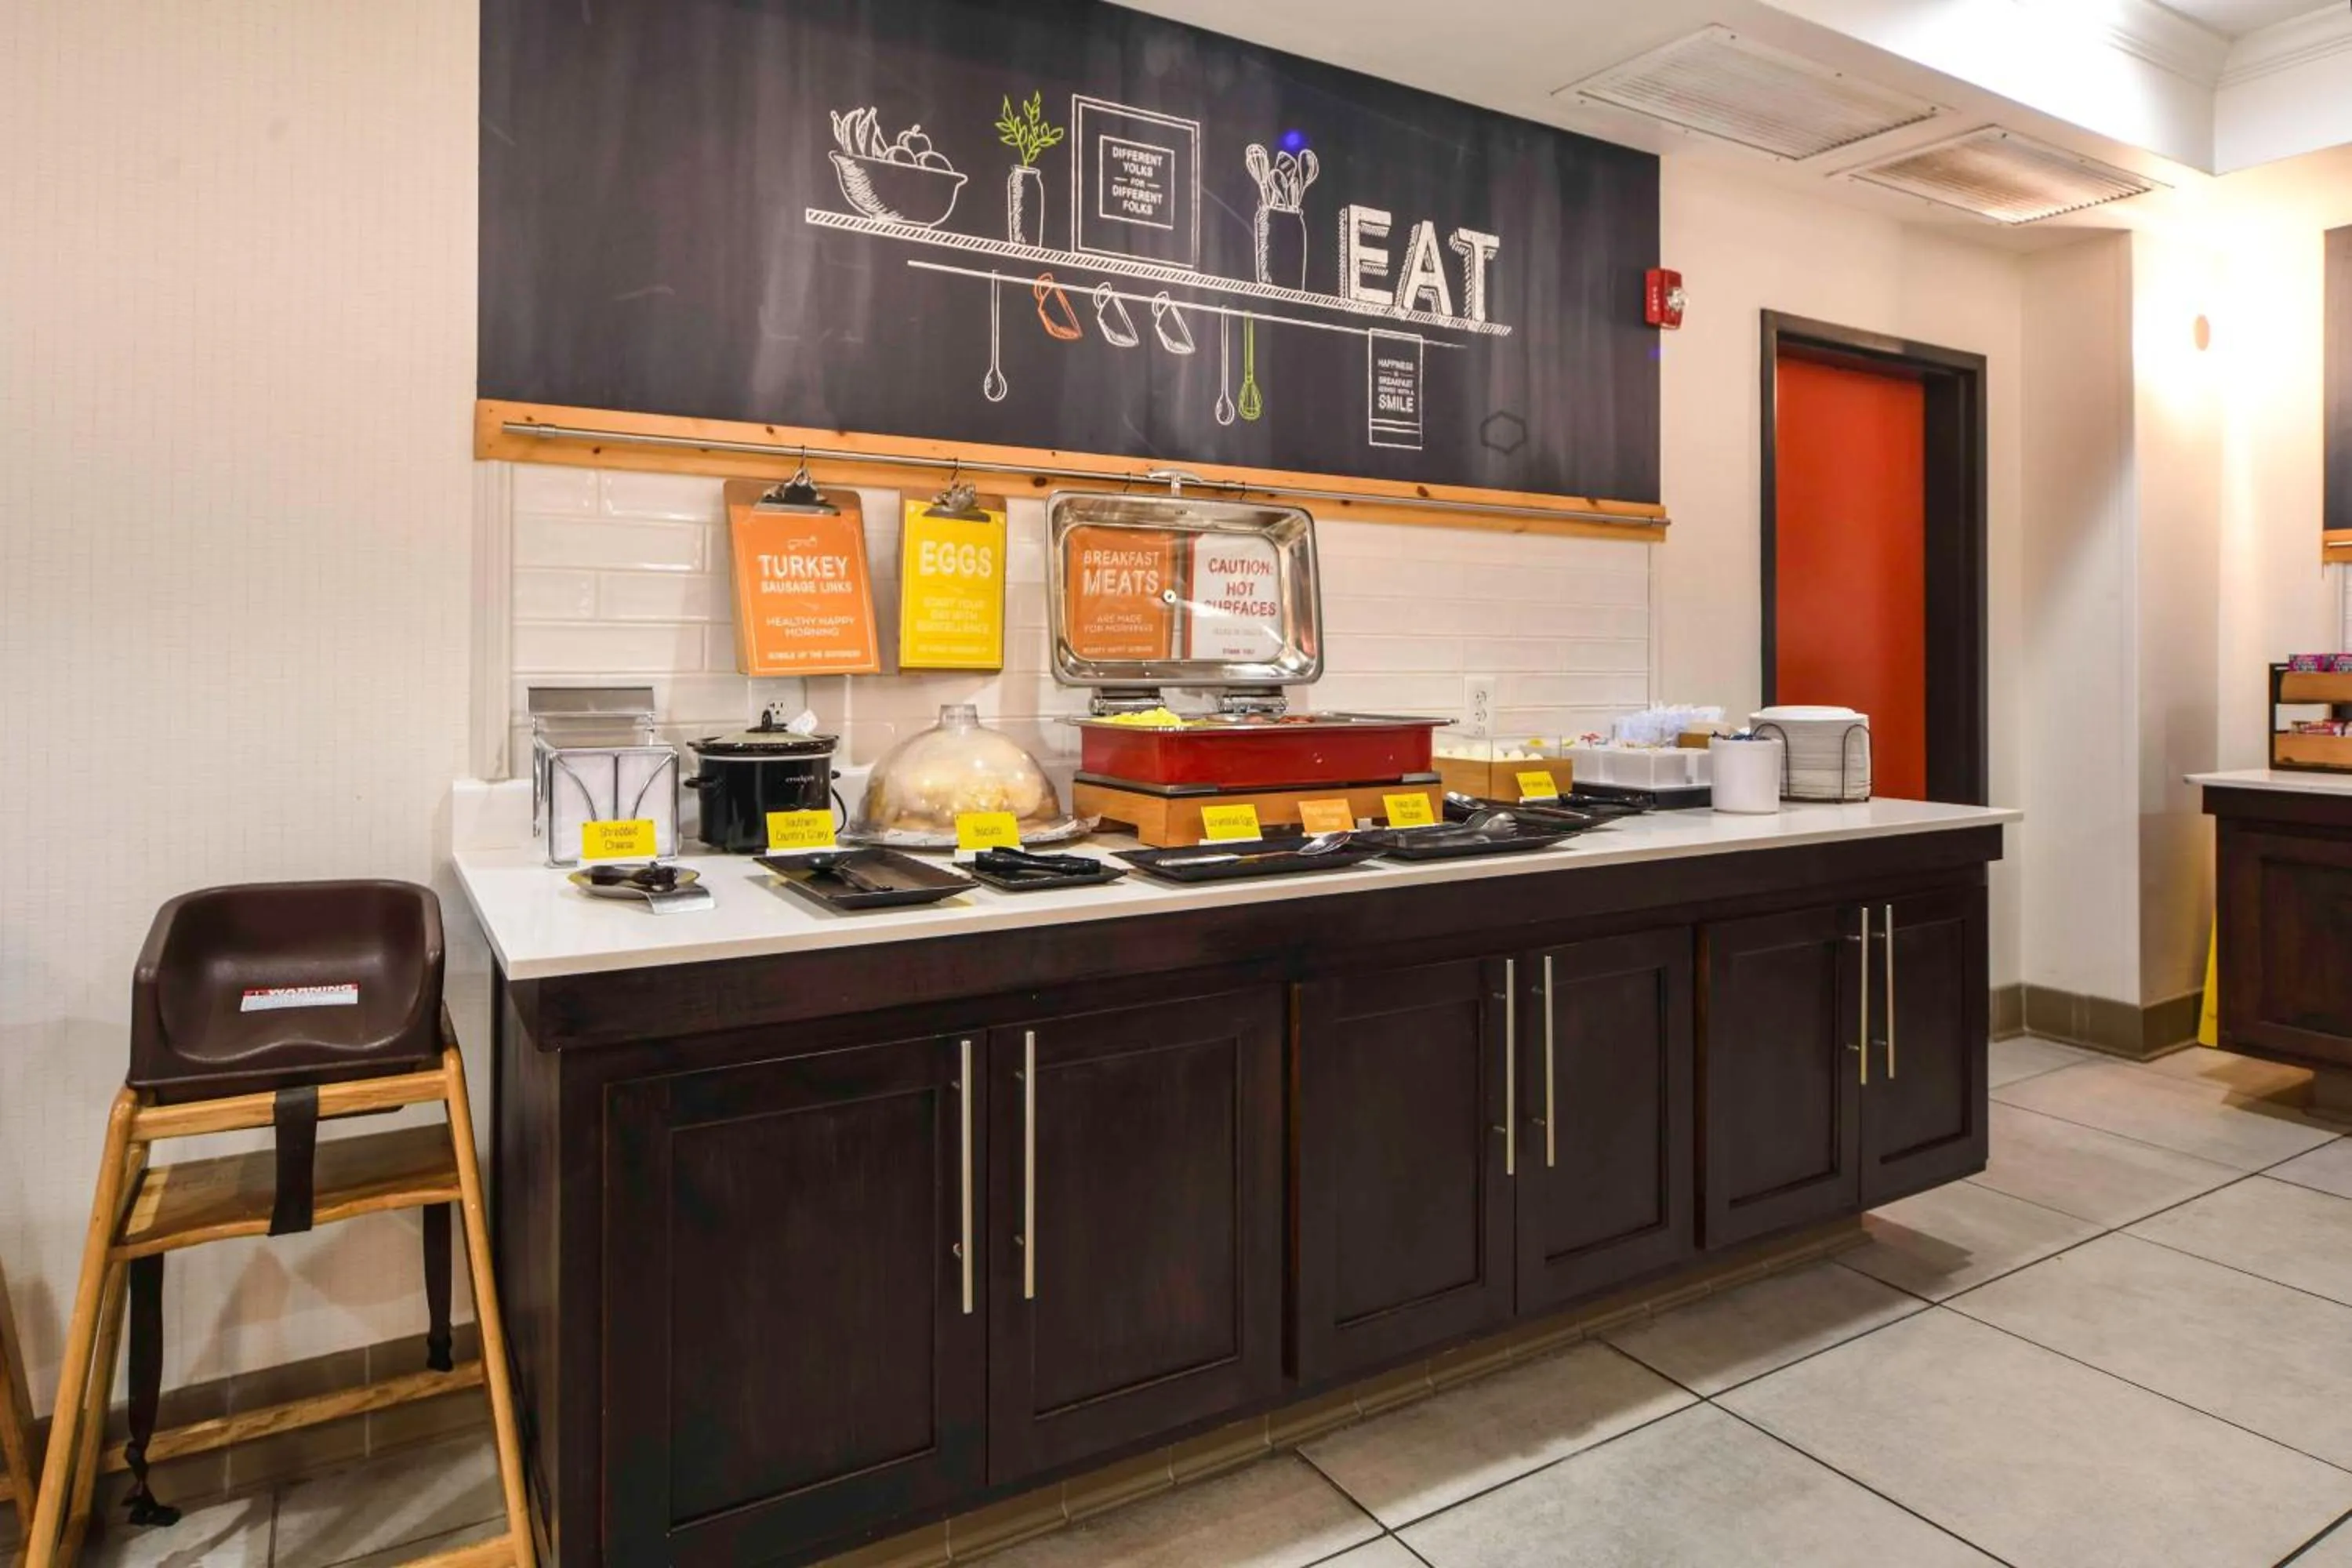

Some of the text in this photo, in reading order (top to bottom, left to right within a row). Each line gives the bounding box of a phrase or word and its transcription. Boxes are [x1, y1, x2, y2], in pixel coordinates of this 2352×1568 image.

[1112, 146, 1163, 166] DIFFERENT
[1123, 162, 1153, 177] YOLKS
[1131, 177, 1145, 188] FOR
[1112, 184, 1163, 204] DIFFERENT
[1123, 200, 1153, 215] FOLKS
[1338, 204, 1500, 322] EAT
[1377, 358, 1414, 371] HAPPINESS
[1378, 376, 1413, 388] BREAKFAST
[1378, 394, 1414, 412] SMILE
[920, 540, 993, 579] EGGS
[1083, 550, 1160, 566] BREAKFAST
[757, 554, 848, 579] TURKEY
[761, 580, 853, 593] SAUSAGE LINKS
[1083, 568, 1159, 597] MEATS
[1225, 582, 1254, 596] HOT
[767, 615, 855, 626] HEALTHY HAPPY
